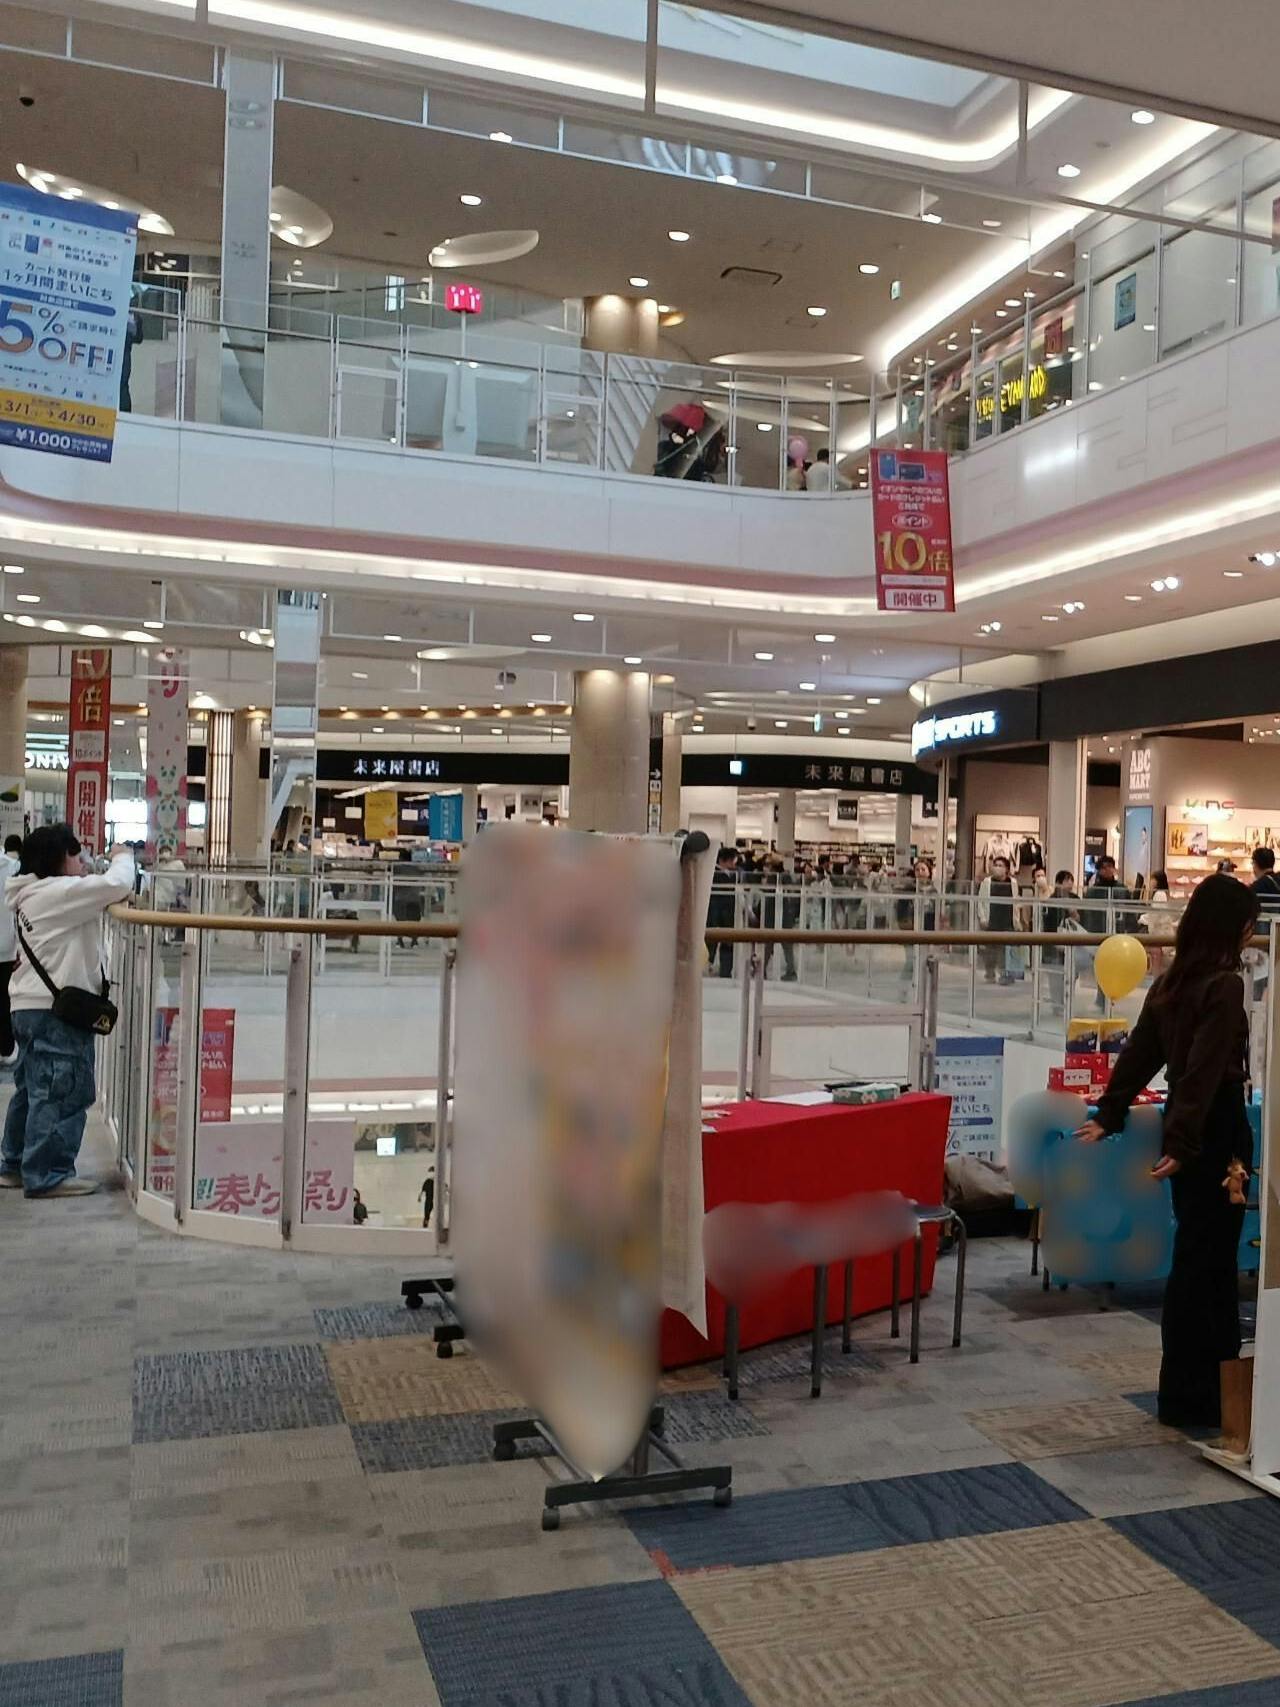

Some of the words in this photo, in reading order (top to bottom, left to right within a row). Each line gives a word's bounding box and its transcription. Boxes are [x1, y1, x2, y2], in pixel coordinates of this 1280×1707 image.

[893, 591, 938, 607] 開催中
[353, 758, 440, 777] 未来屋書店
[1129, 748, 1151, 773] ABC
[804, 763, 902, 785] 未来屋書店
